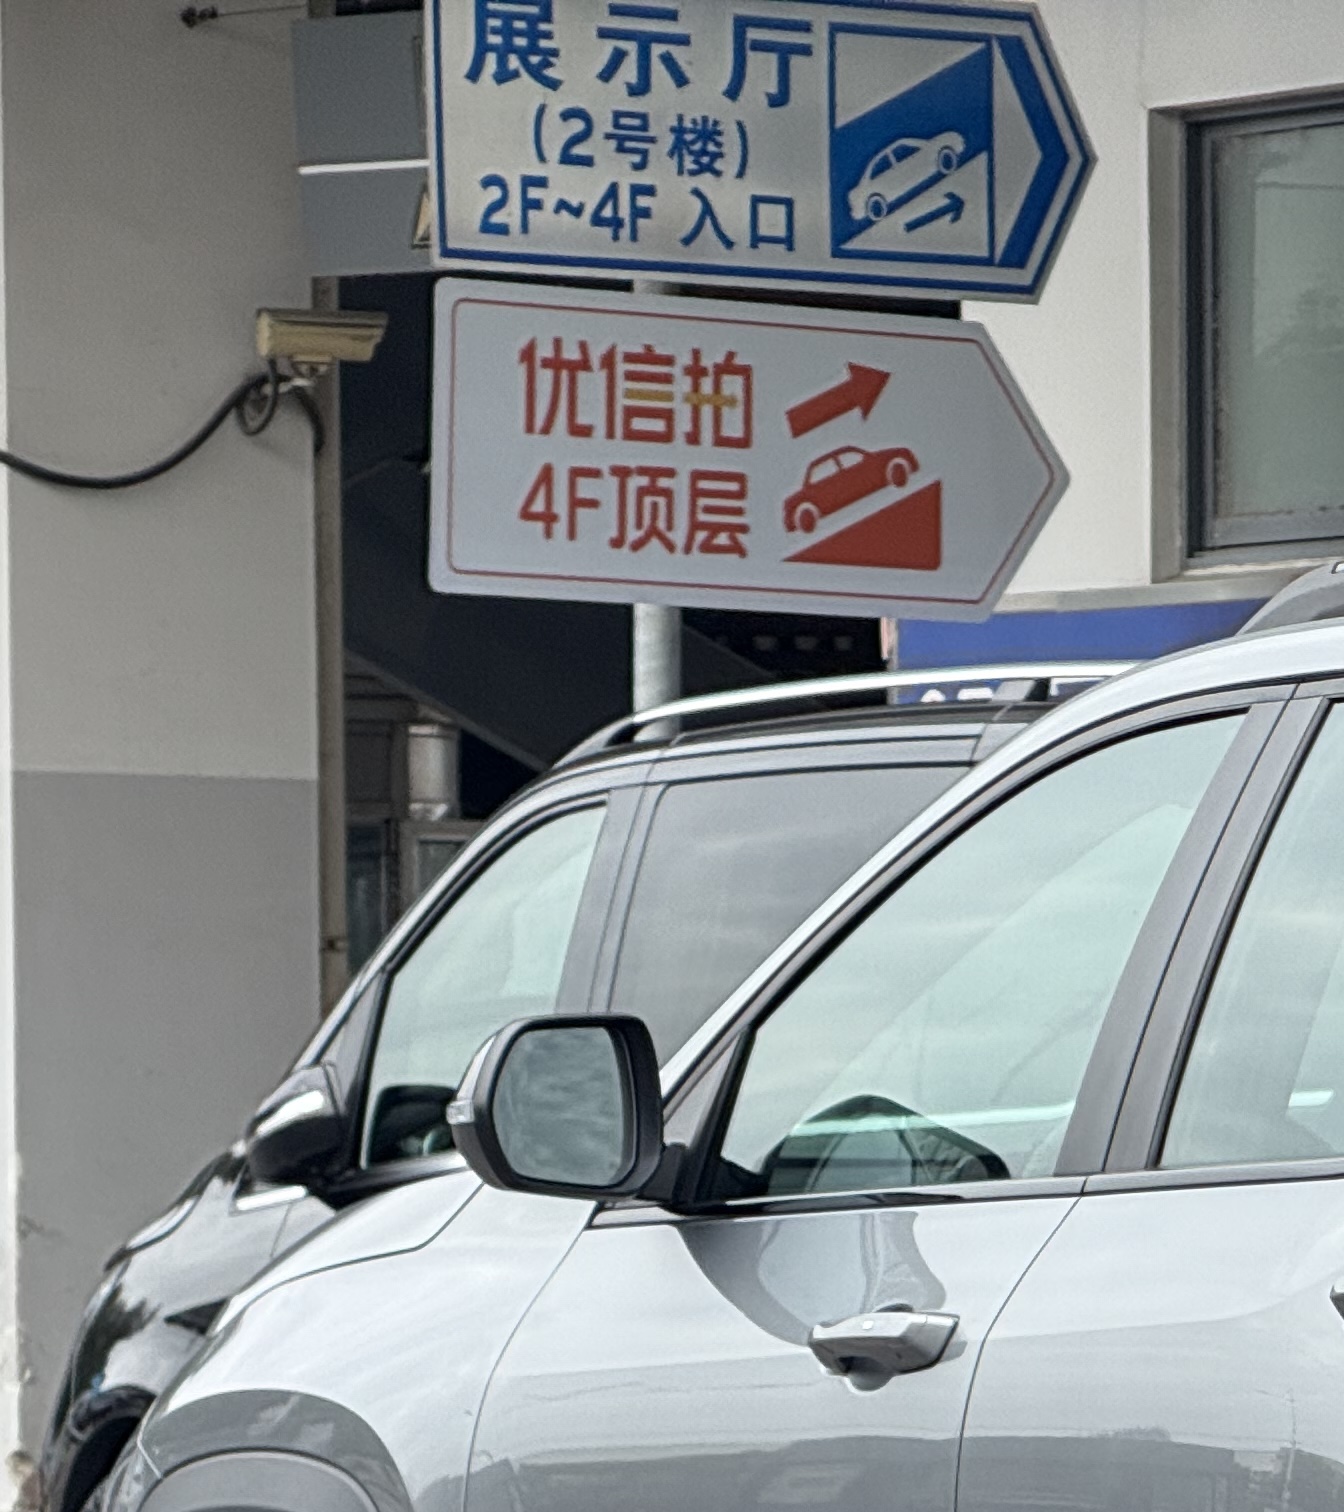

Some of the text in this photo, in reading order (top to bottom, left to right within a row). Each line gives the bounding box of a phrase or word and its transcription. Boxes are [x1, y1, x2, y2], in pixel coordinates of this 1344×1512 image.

[464, 0, 813, 108] 展示厅
[532, 103, 751, 180] (2号楼)
[478, 174, 796, 252] 2F~4F 入口
[518, 335, 754, 450] 优信拍
[518, 463, 751, 559] 4F顶层
